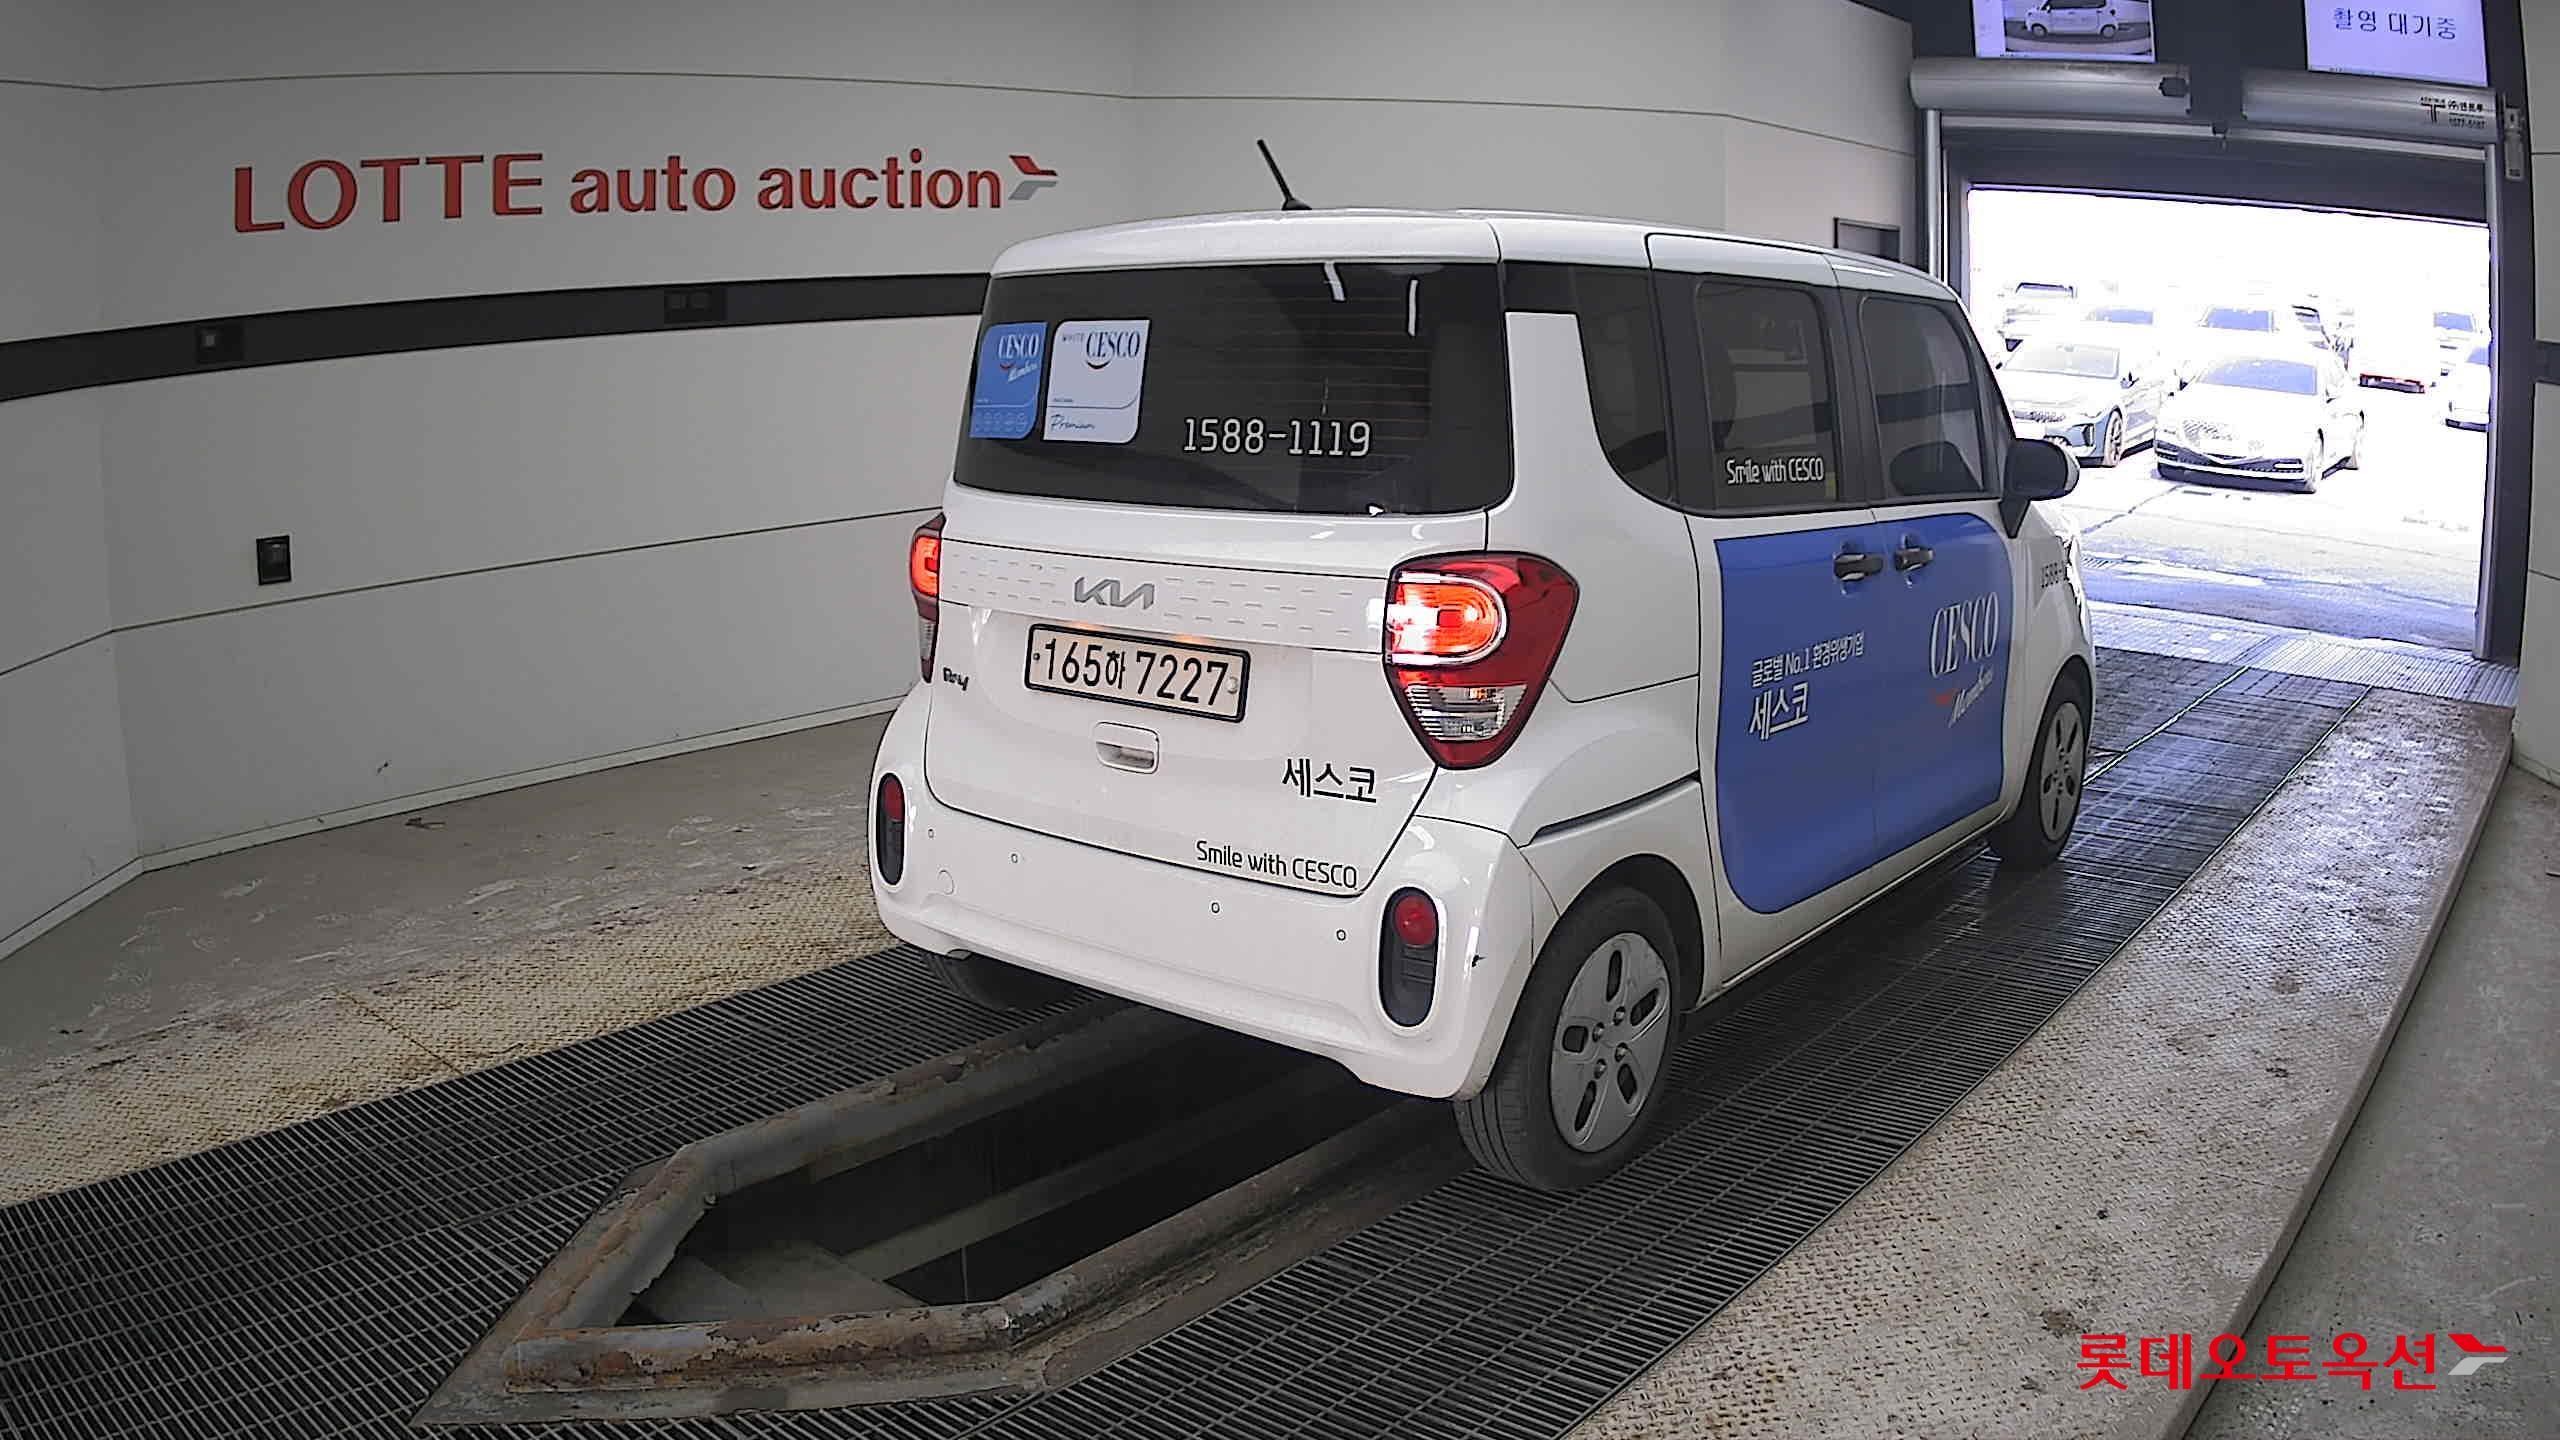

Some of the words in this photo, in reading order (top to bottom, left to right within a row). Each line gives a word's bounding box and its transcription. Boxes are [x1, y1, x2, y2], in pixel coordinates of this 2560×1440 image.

[2334, 7, 2377, 33] 촬영
[2388, 12, 2457, 40] 대기중
[233, 151, 544, 233] LOTTE
[569, 154, 737, 214] auto
[757, 147, 1002, 210] auction
[998, 333, 1040, 360] CESCO
[1085, 330, 1142, 359] CESCO
[1182, 416, 1372, 458] 1588-1119
[1726, 458, 1761, 485] Smile
[1761, 457, 1788, 483] with
[1788, 456, 1825, 482] CESCO
[1930, 591, 1999, 680] CESCO
[1752, 654, 1784, 688] 글로벌
[1784, 647, 1810, 676] No.1
[1749, 682, 1809, 740] 세스코
[1282, 757, 1377, 804] 세스코
[1196, 839, 1243, 870] Smile
[1248, 850, 1287, 878] with
[1291, 856, 1358, 890] CESCO
